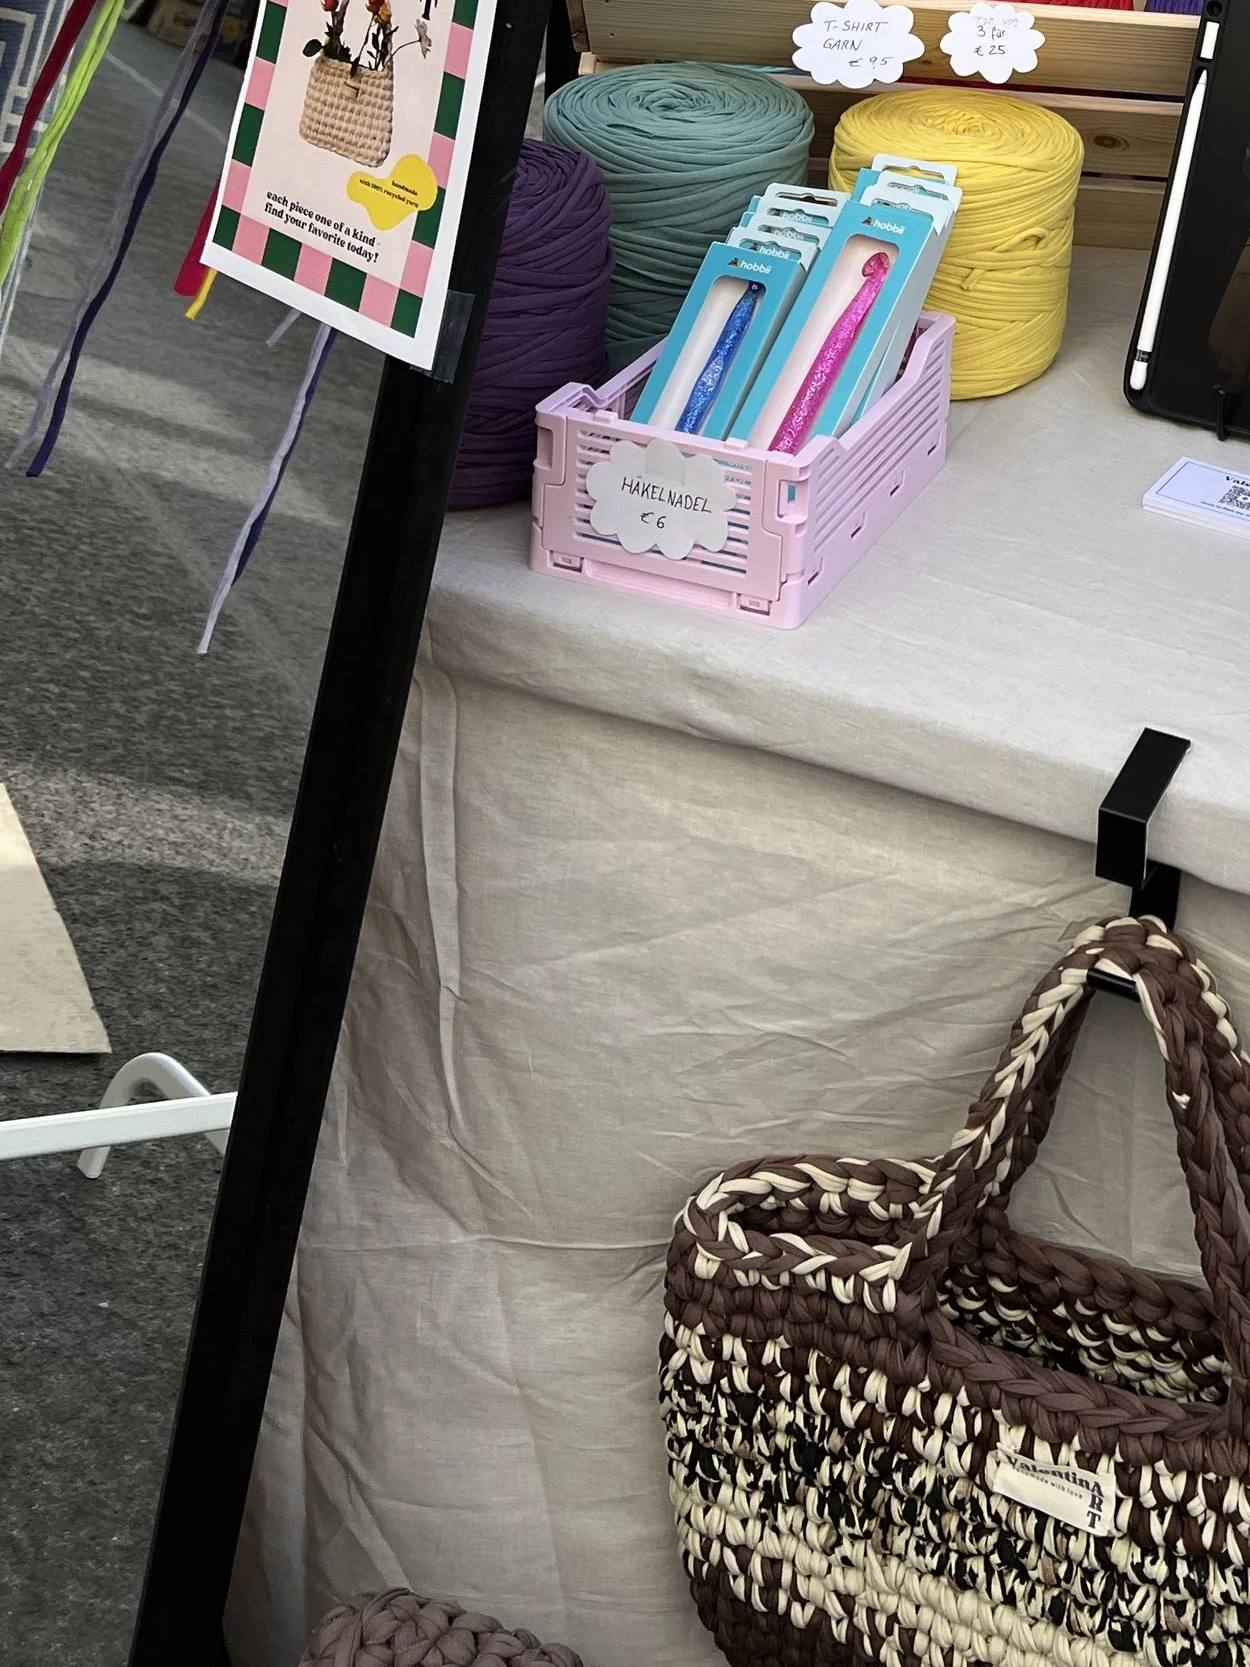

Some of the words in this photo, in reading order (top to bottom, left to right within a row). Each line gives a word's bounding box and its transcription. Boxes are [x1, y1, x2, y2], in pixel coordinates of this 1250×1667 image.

[976, 25, 986, 38] 3
[823, 38, 862, 51] GARN
[988, 45, 1006, 55] 25
[266, 191, 289, 207] each
[289, 202, 314, 219] piece
[315, 214, 333, 227] one
[333, 221, 345, 233] of
[344, 227, 351, 236] a
[352, 228, 376, 247] kind
[264, 202, 284, 219] find
[284, 213, 308, 229] your
[308, 222, 346, 248] favorite
[346, 242, 380, 263] today!
[873, 219, 905, 235] hobbii
[759, 245, 790, 259] hobbii
[740, 259, 772, 274] hobbii
[621, 475, 713, 514] HÄKELNADEL
[656, 516, 667, 529] 6
